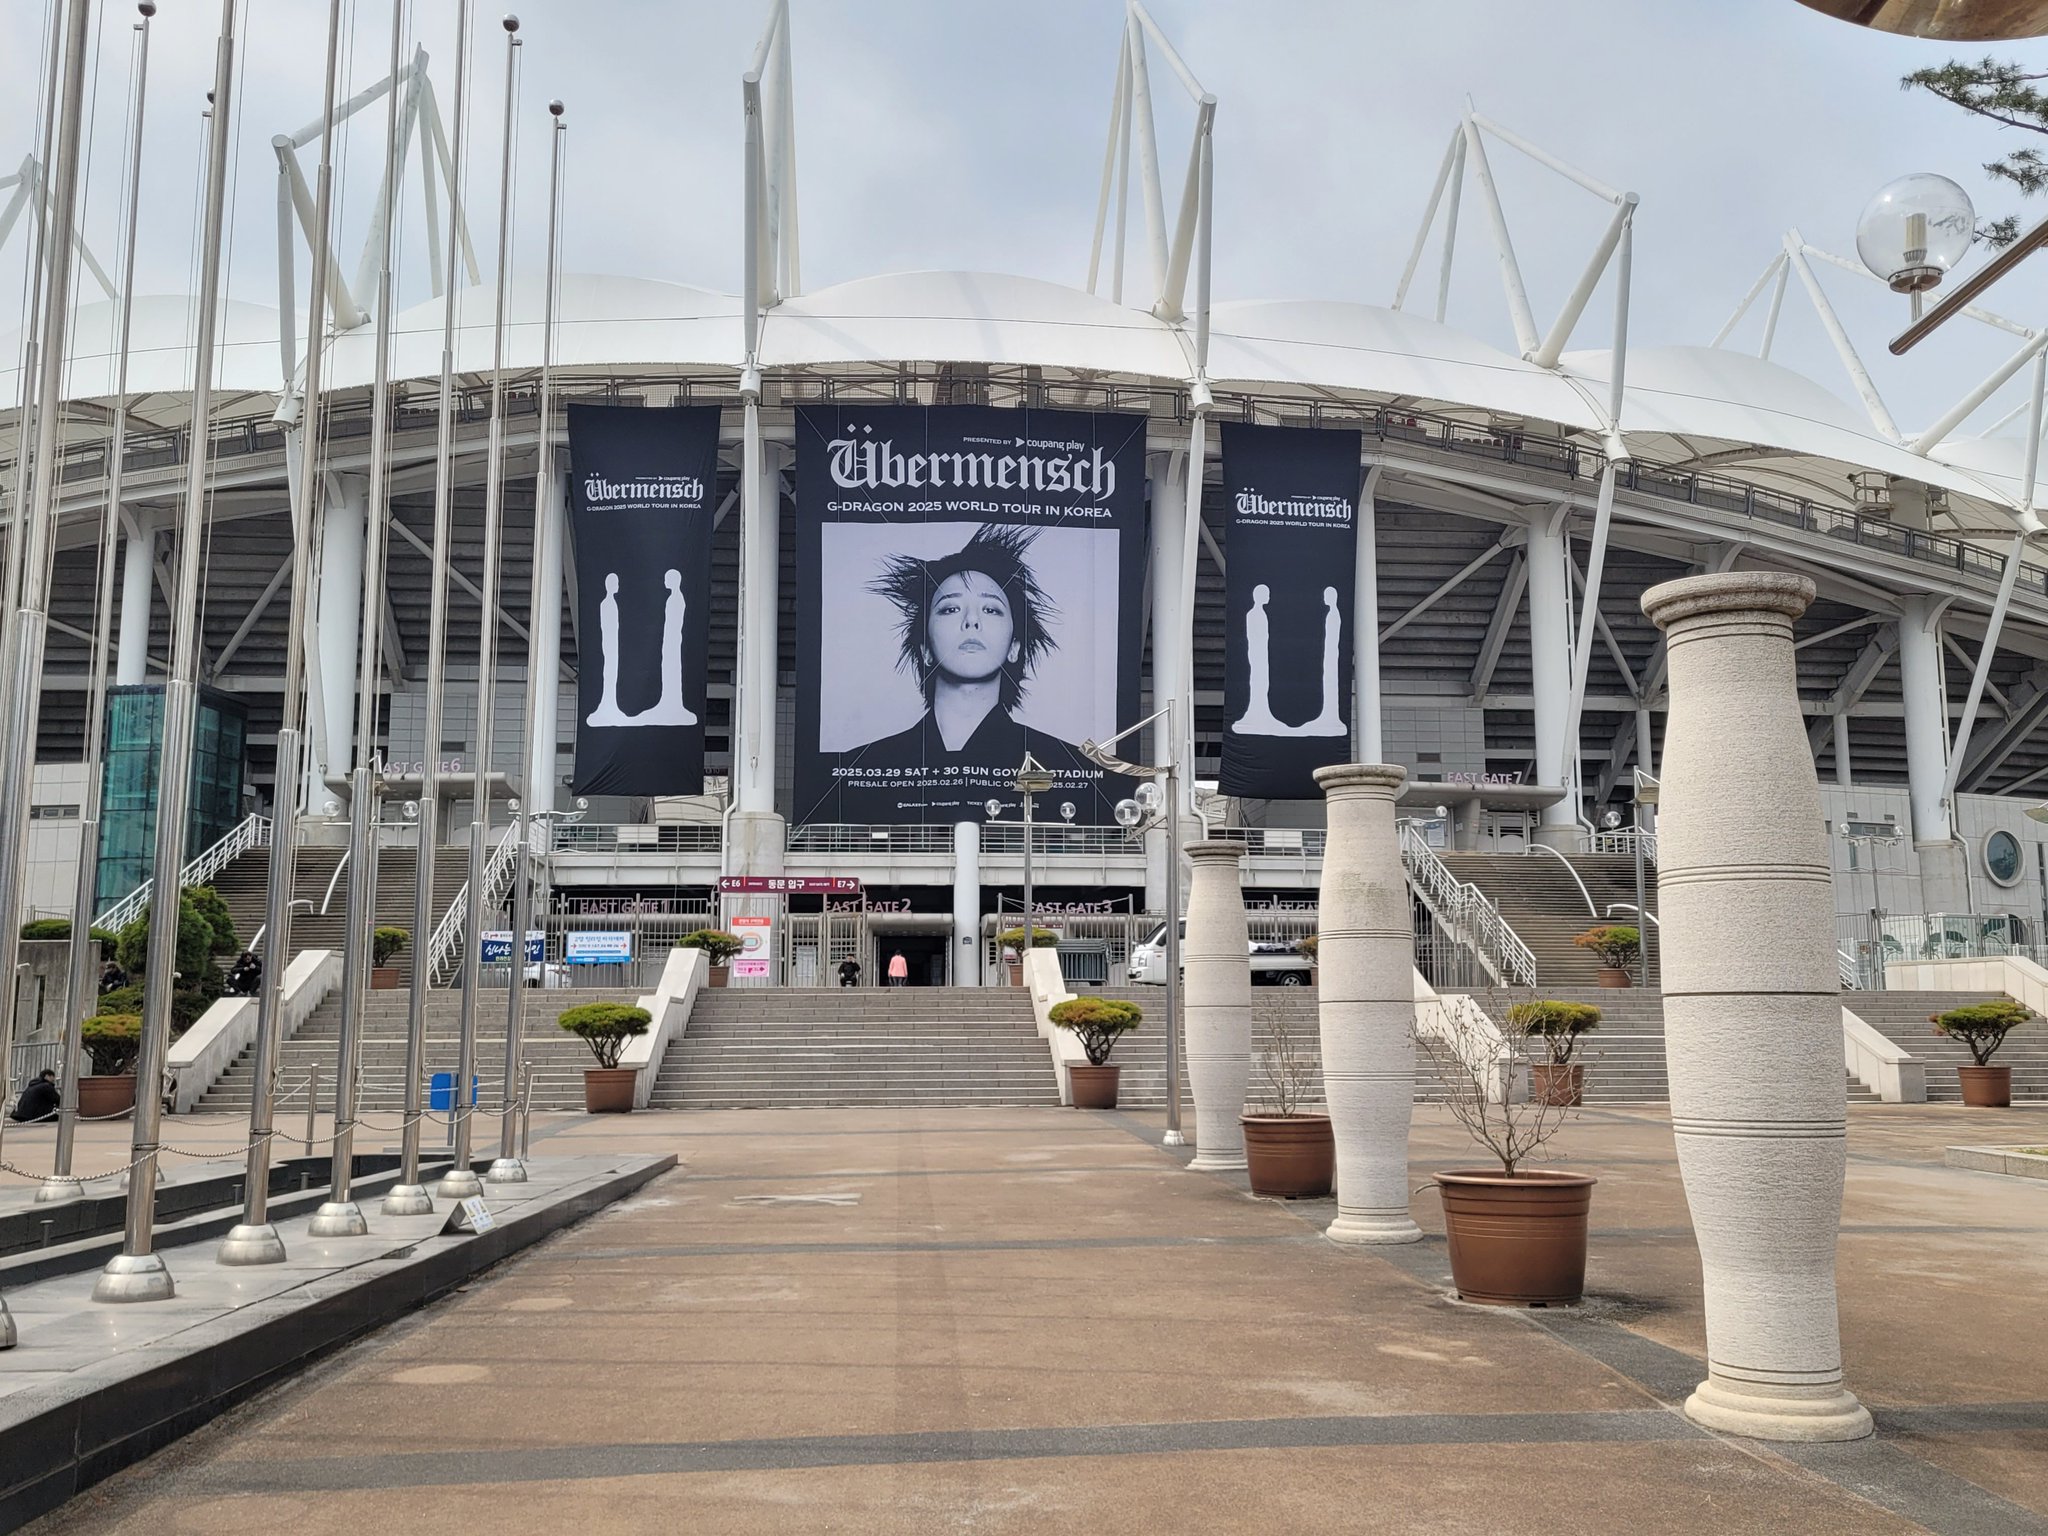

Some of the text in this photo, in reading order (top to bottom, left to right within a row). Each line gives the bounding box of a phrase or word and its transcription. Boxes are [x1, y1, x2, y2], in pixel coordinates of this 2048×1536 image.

[963, 436, 1001, 445] PRESENTED
[1027, 439, 1065, 451] coupang
[1066, 440, 1085, 452] play
[827, 423, 1116, 501] Übermensch
[584, 472, 703, 501] Übermensch
[827, 501, 1112, 518] G-DRAGON 2025 WORLD TOUR IN KOREA
[1235, 487, 1351, 522] Übermensch
[382, 761, 409, 773] AST
[413, 761, 449, 773] GTE
[832, 768, 901, 777] 2025.03.29
[904, 767, 929, 776] SAT
[943, 767, 959, 775] 30
[962, 766, 989, 775] SUN
[917, 779, 963, 787] 2025.02.26
[970, 779, 1001, 787] PUBLIC
[1447, 772, 1477, 784] EAST
[768, 879, 785, 889] 동문
[788, 879, 805, 889] 입구
[837, 880, 847, 888] E7
[580, 902, 617, 914] EAST
[826, 901, 859, 913] EAST
